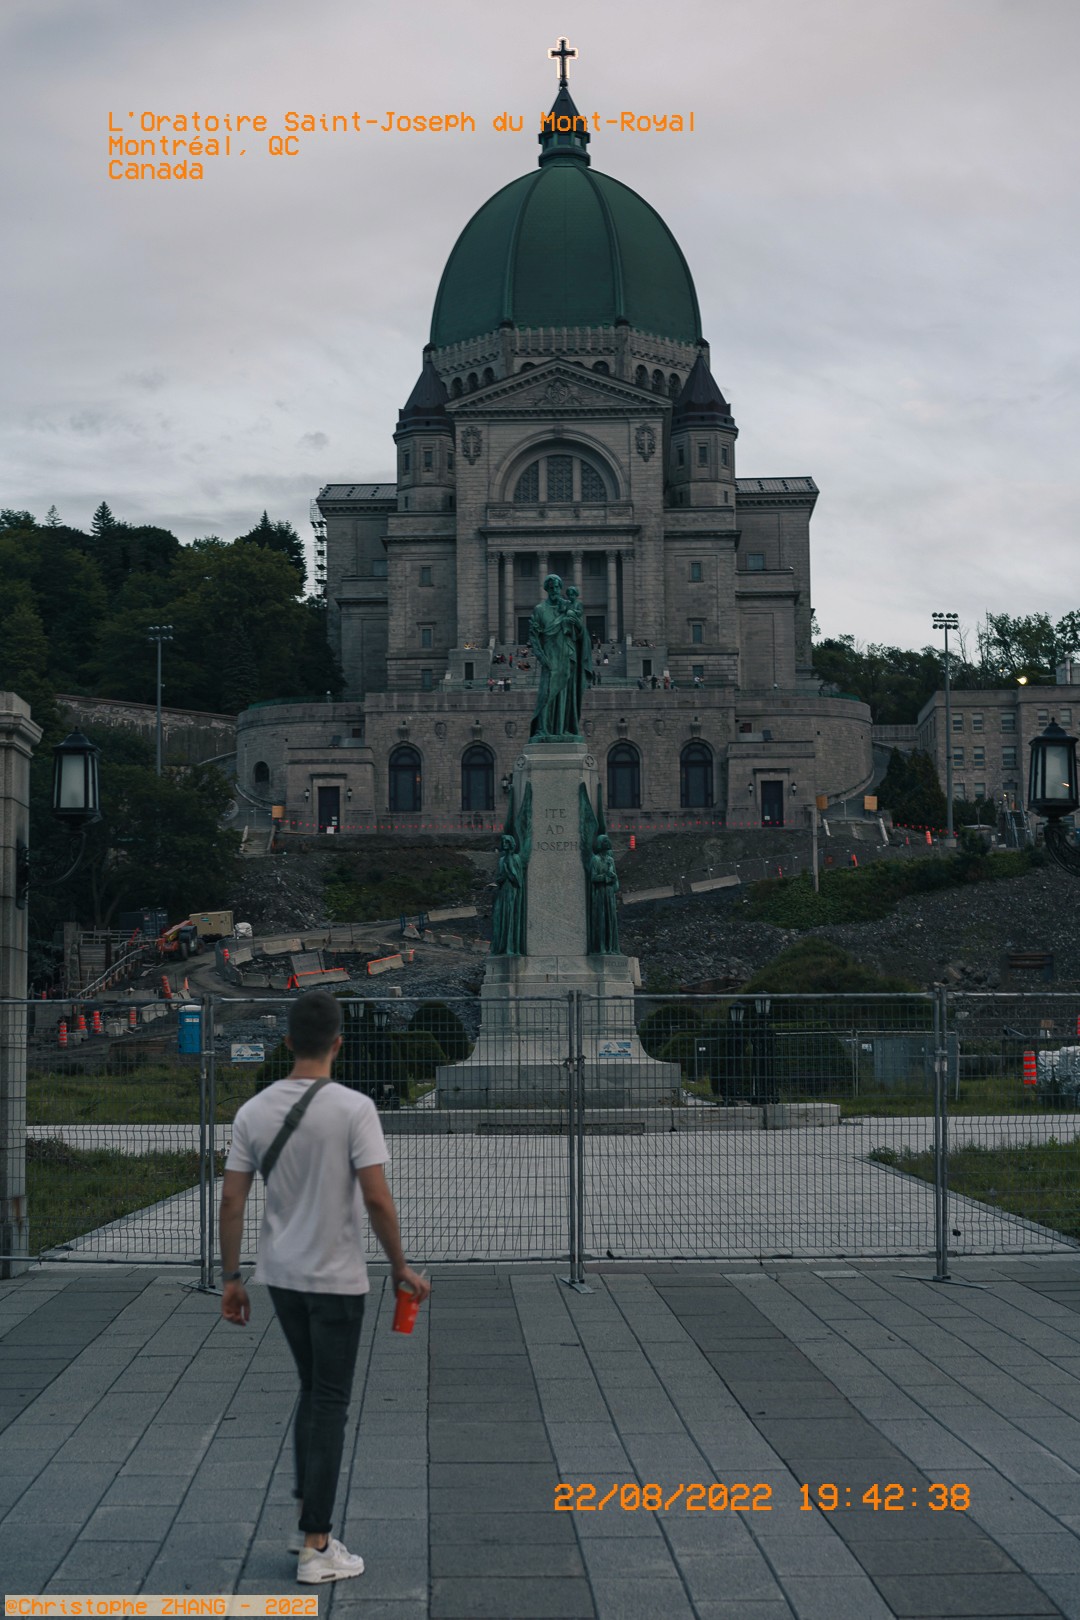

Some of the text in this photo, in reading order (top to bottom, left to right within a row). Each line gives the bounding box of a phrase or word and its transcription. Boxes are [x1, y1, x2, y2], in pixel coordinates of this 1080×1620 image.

[545, 808, 567, 819] ITE
[545, 825, 565, 835] AD
[534, 841, 578, 852] JOSEPH
